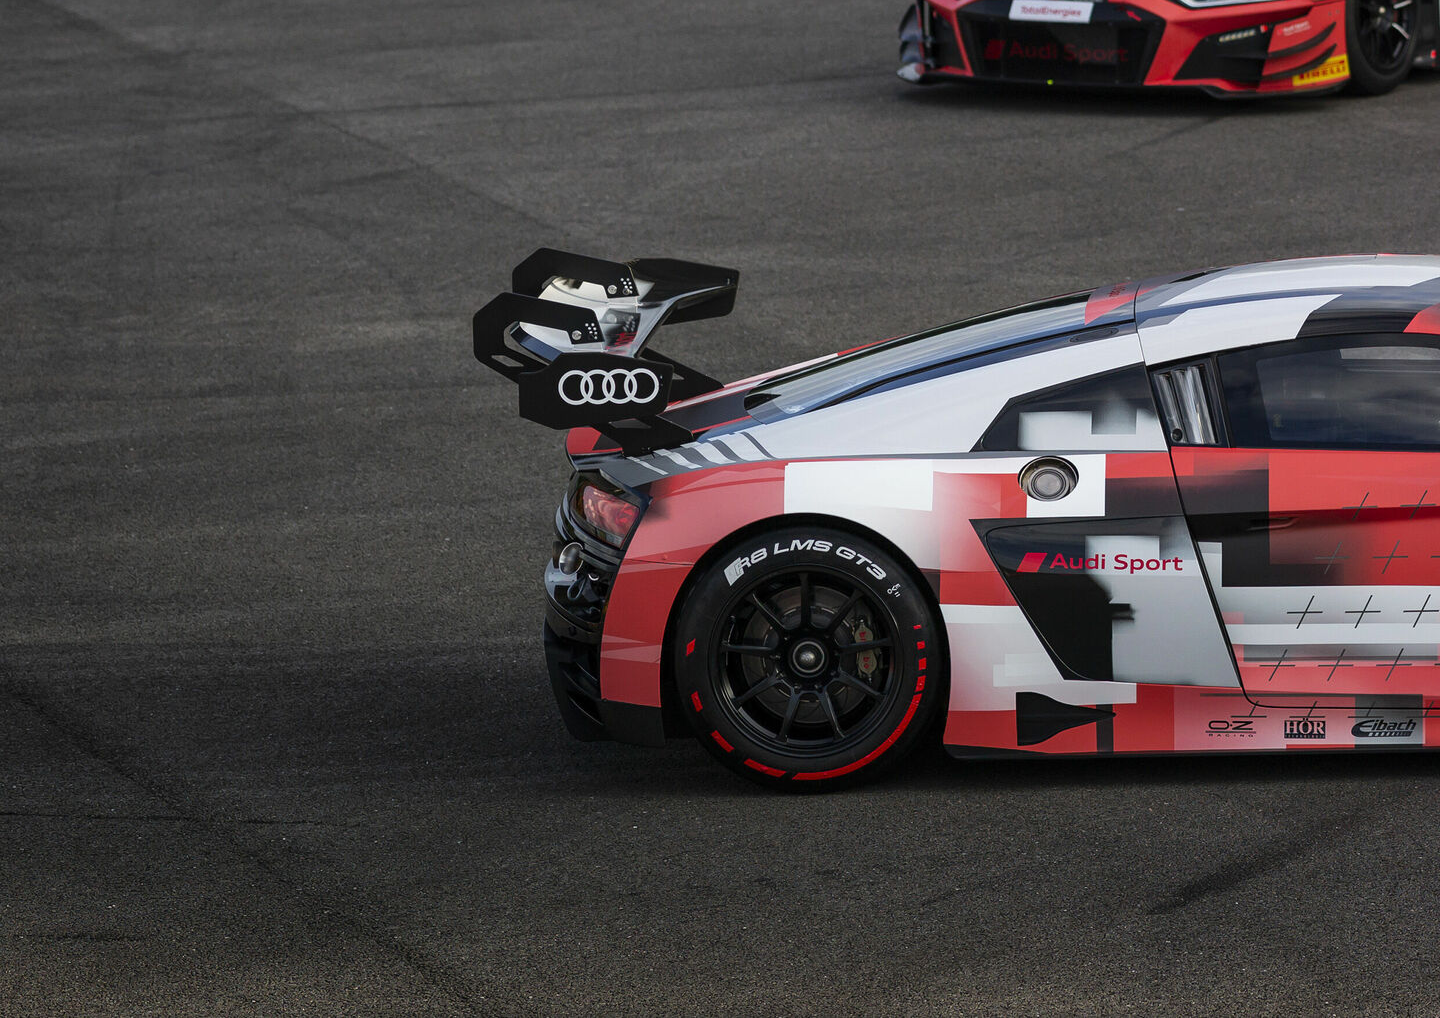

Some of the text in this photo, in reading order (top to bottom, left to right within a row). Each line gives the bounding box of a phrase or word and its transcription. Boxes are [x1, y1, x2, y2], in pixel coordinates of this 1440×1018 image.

[1009, 40, 1129, 63] Audi Sport
[728, 539, 888, 581] R8 LMS GT3
[1049, 553, 1183, 574] Audi Sport
[1285, 717, 1325, 734] HÖR
[1351, 719, 1417, 737] Eibach
